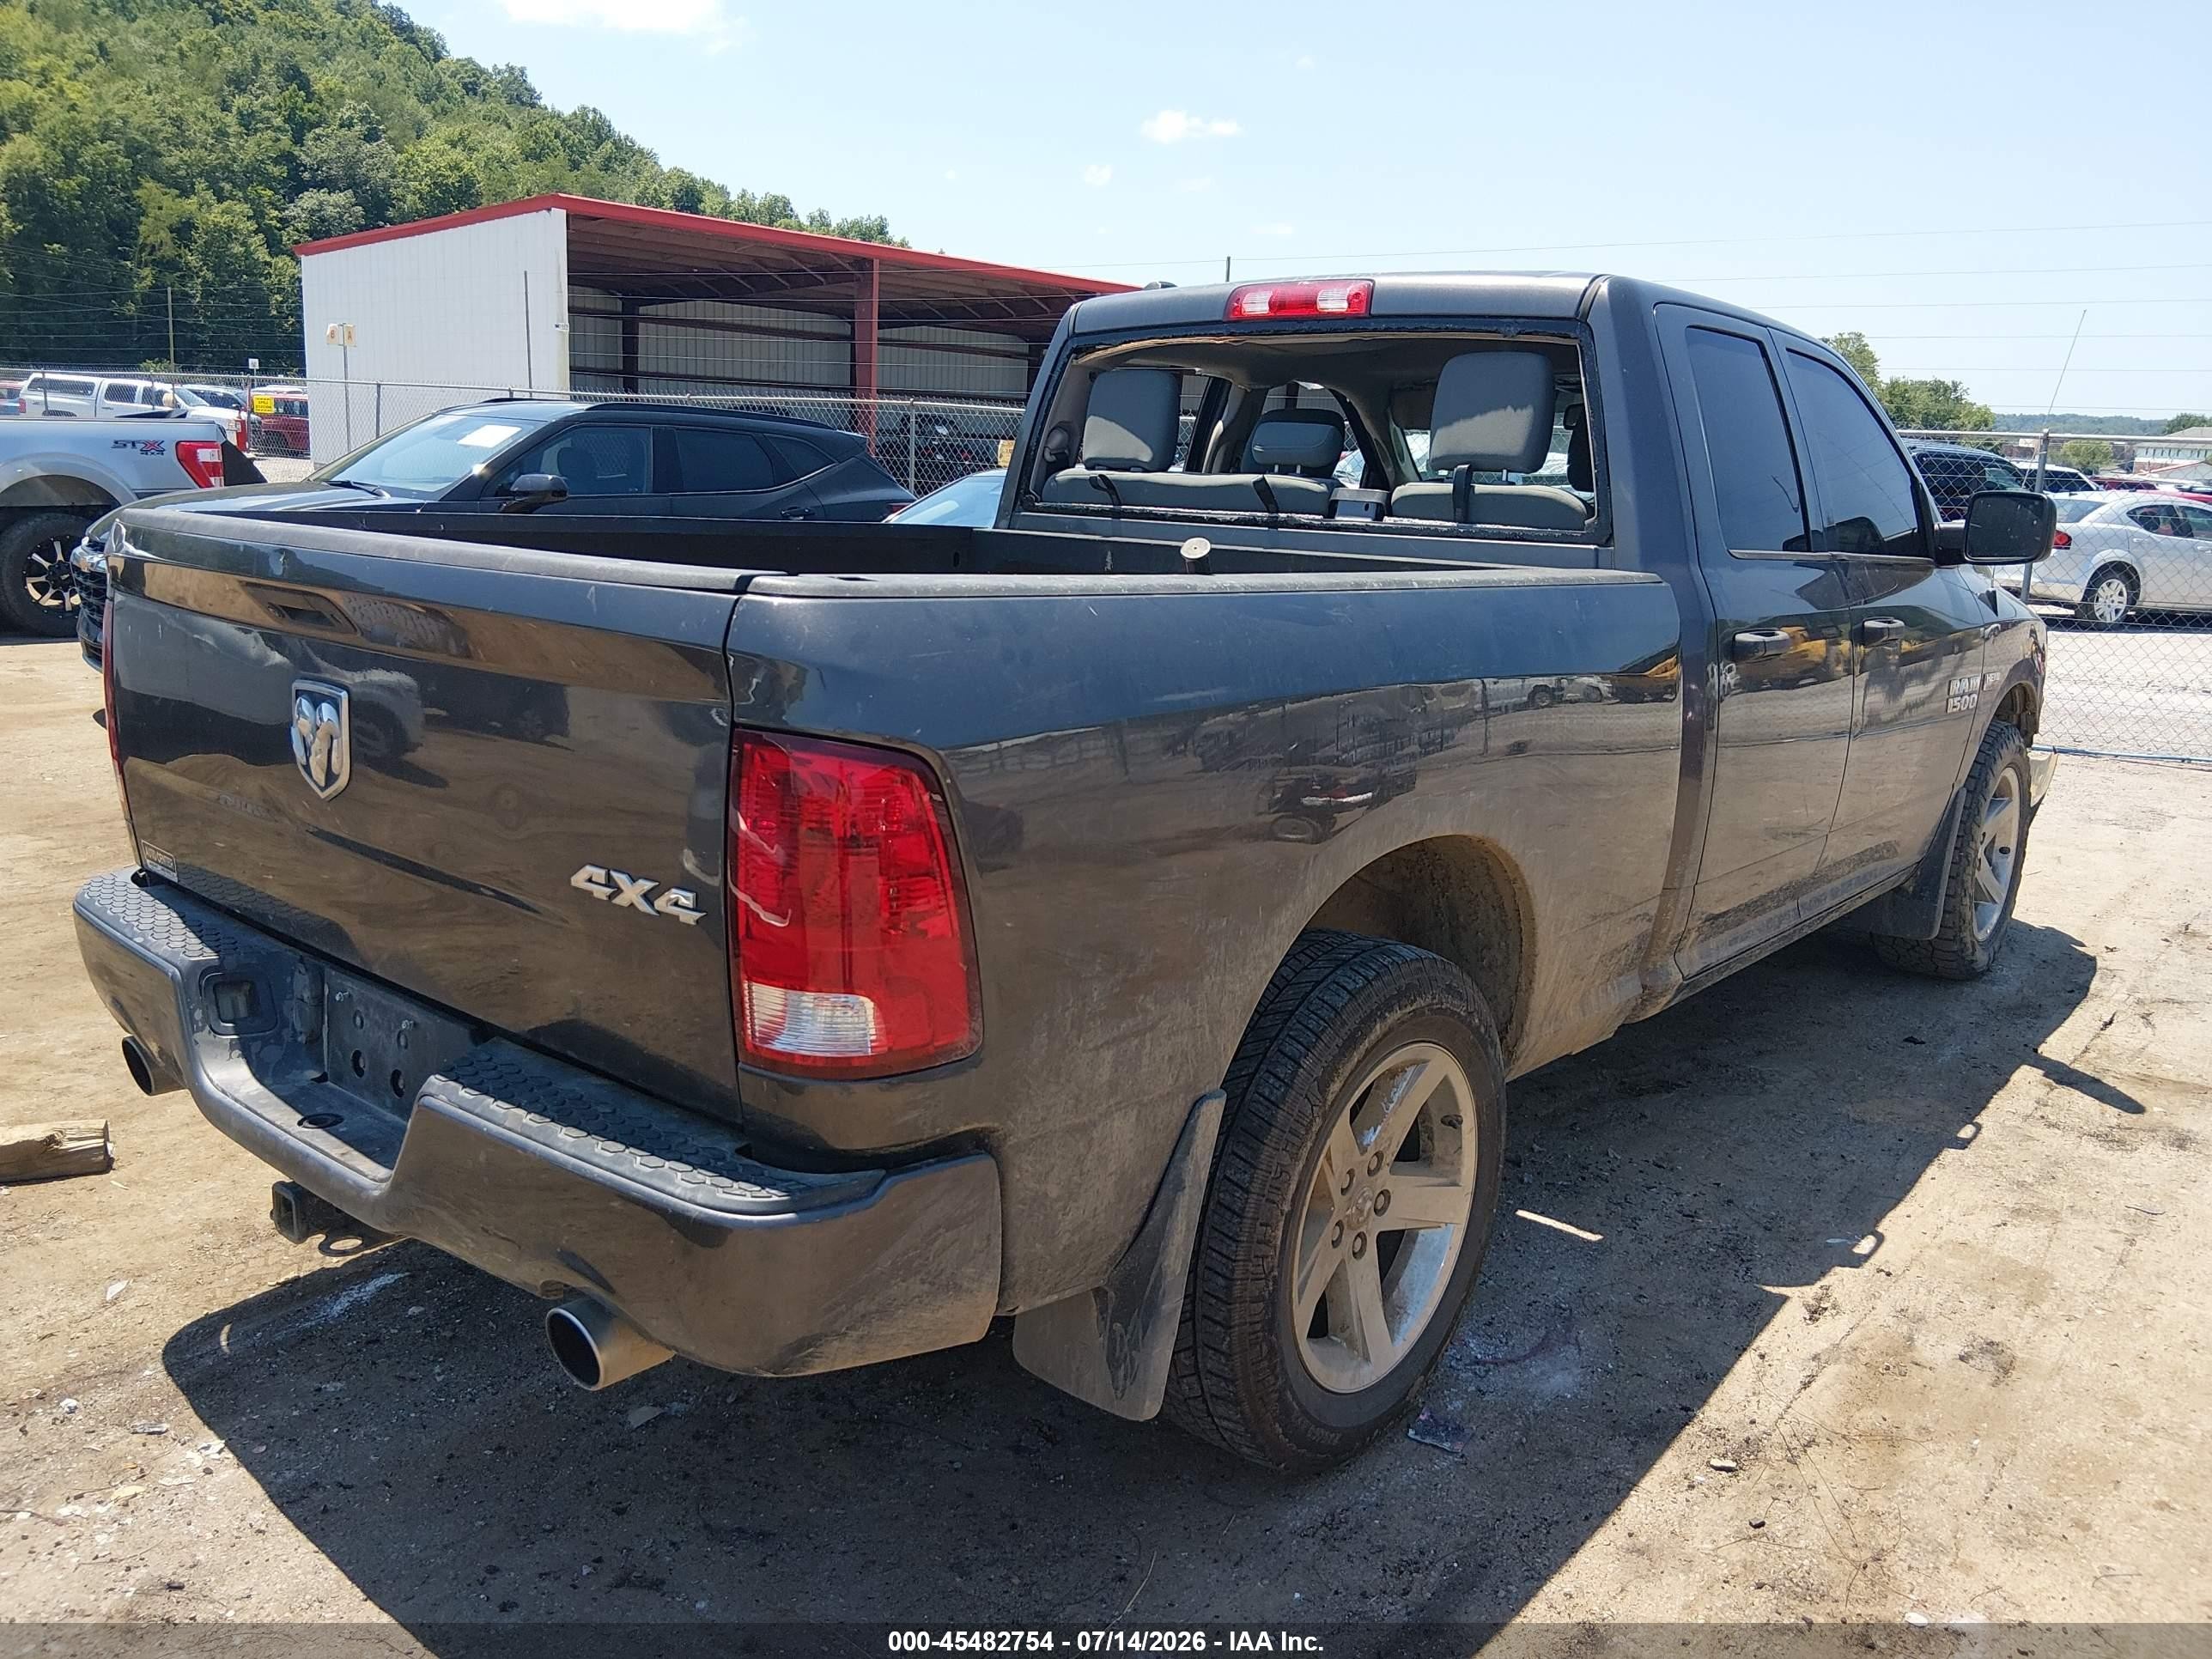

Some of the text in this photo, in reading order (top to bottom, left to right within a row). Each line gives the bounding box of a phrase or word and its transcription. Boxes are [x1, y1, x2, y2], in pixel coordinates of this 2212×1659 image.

[348, 331, 353, 341] A
[111, 439, 166, 452] STX
[1948, 676, 1981, 696] RAM
[1946, 693, 1978, 714] 1500
[570, 862, 708, 925] 4X4
